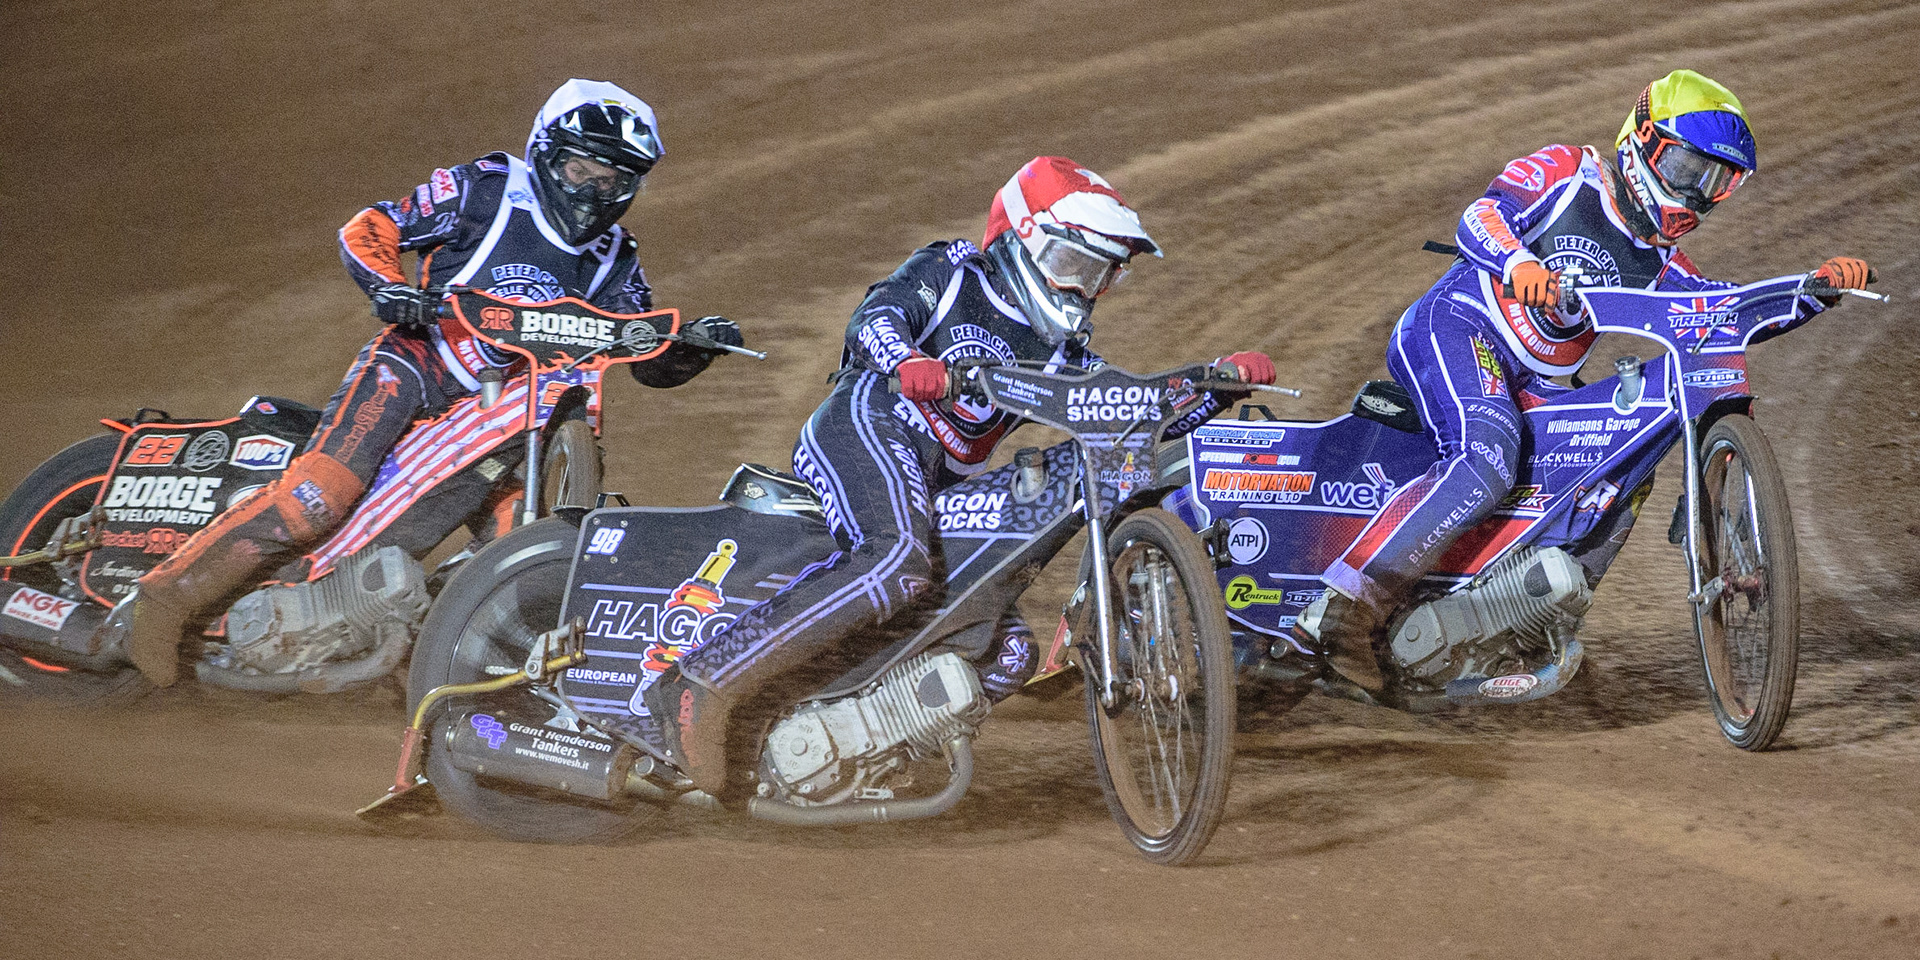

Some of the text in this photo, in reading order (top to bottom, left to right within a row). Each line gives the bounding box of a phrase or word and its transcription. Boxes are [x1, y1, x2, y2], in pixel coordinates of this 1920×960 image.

[946, 240, 974, 260] HAG
[951, 246, 978, 266] SHO
[1555, 235, 1600, 258] PETER
[491, 264, 540, 283] PETER
[1548, 256, 1582, 271] BELLE
[521, 311, 616, 342] BORGE
[1508, 303, 1557, 356] MEMORIAL
[1667, 312, 1739, 328] TRS-UK
[950, 324, 991, 345] PETER
[993, 373, 1053, 398] Grant Henderson
[1007, 385, 1035, 399] Tankers
[1067, 386, 1162, 407] HAGON
[1067, 404, 1162, 422] SHOCKS
[1196, 427, 1284, 440] BRADSHAW FENCING
[1547, 417, 1641, 434] Williamsons Garage
[128, 436, 186, 464] 22
[1205, 436, 1268, 445] SERVICES
[1569, 433, 1613, 447] Driffield
[237, 441, 286, 463] 100%
[1101, 470, 1153, 483] HAGON
[1204, 471, 1314, 492] MOTORVATION
[103, 475, 223, 513] BORGE
[793, 444, 842, 534] HAGON
[1212, 490, 1300, 501] TRAINING LTD
[934, 493, 1008, 512] AGON
[939, 512, 1001, 531] OCKS
[1408, 488, 1484, 565] BLACKWELL'S
[586, 527, 626, 555] 98
[1231, 533, 1258, 547] ATPI
[1231, 583, 1280, 602] Rentruck
[13, 590, 71, 618] NGK
[585, 600, 738, 646] HAGO
[566, 668, 637, 684] EUROPEAN
[509, 722, 612, 753] Grant Henderson
[531, 738, 580, 758] Tankers
[515, 746, 590, 771] www.wemovesh.it
